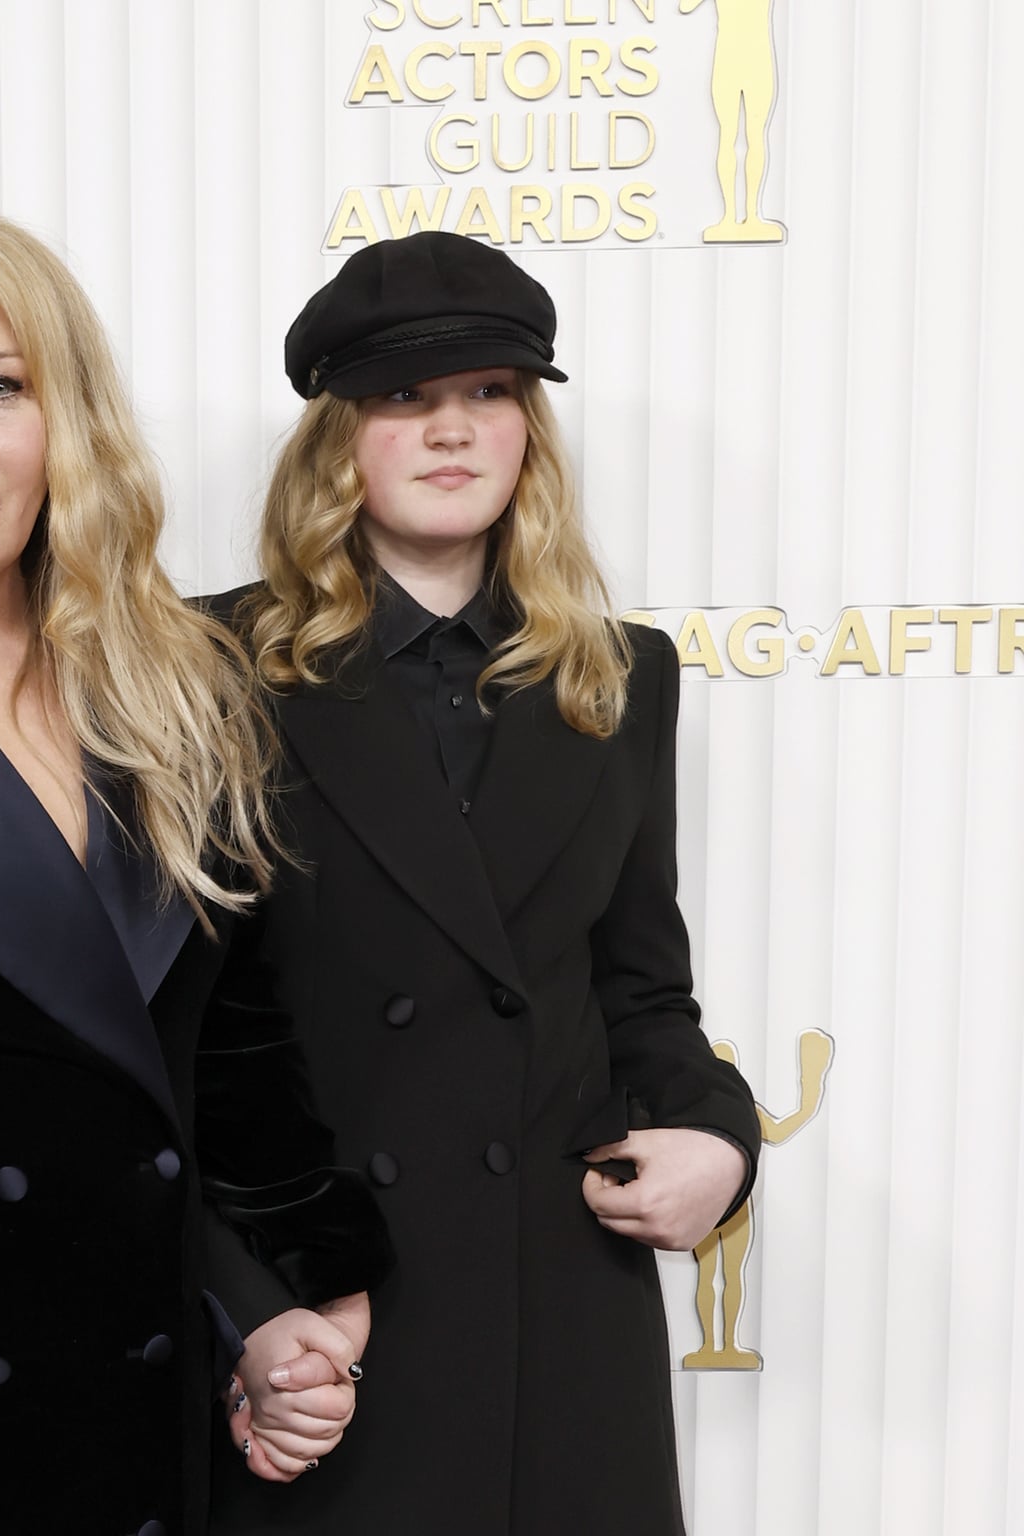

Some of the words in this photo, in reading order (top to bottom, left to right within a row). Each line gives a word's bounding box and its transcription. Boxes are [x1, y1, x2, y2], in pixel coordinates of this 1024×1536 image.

[348, 36, 660, 104] ACTORS
[429, 109, 656, 173] GUILD
[327, 182, 659, 248] AWARDS
